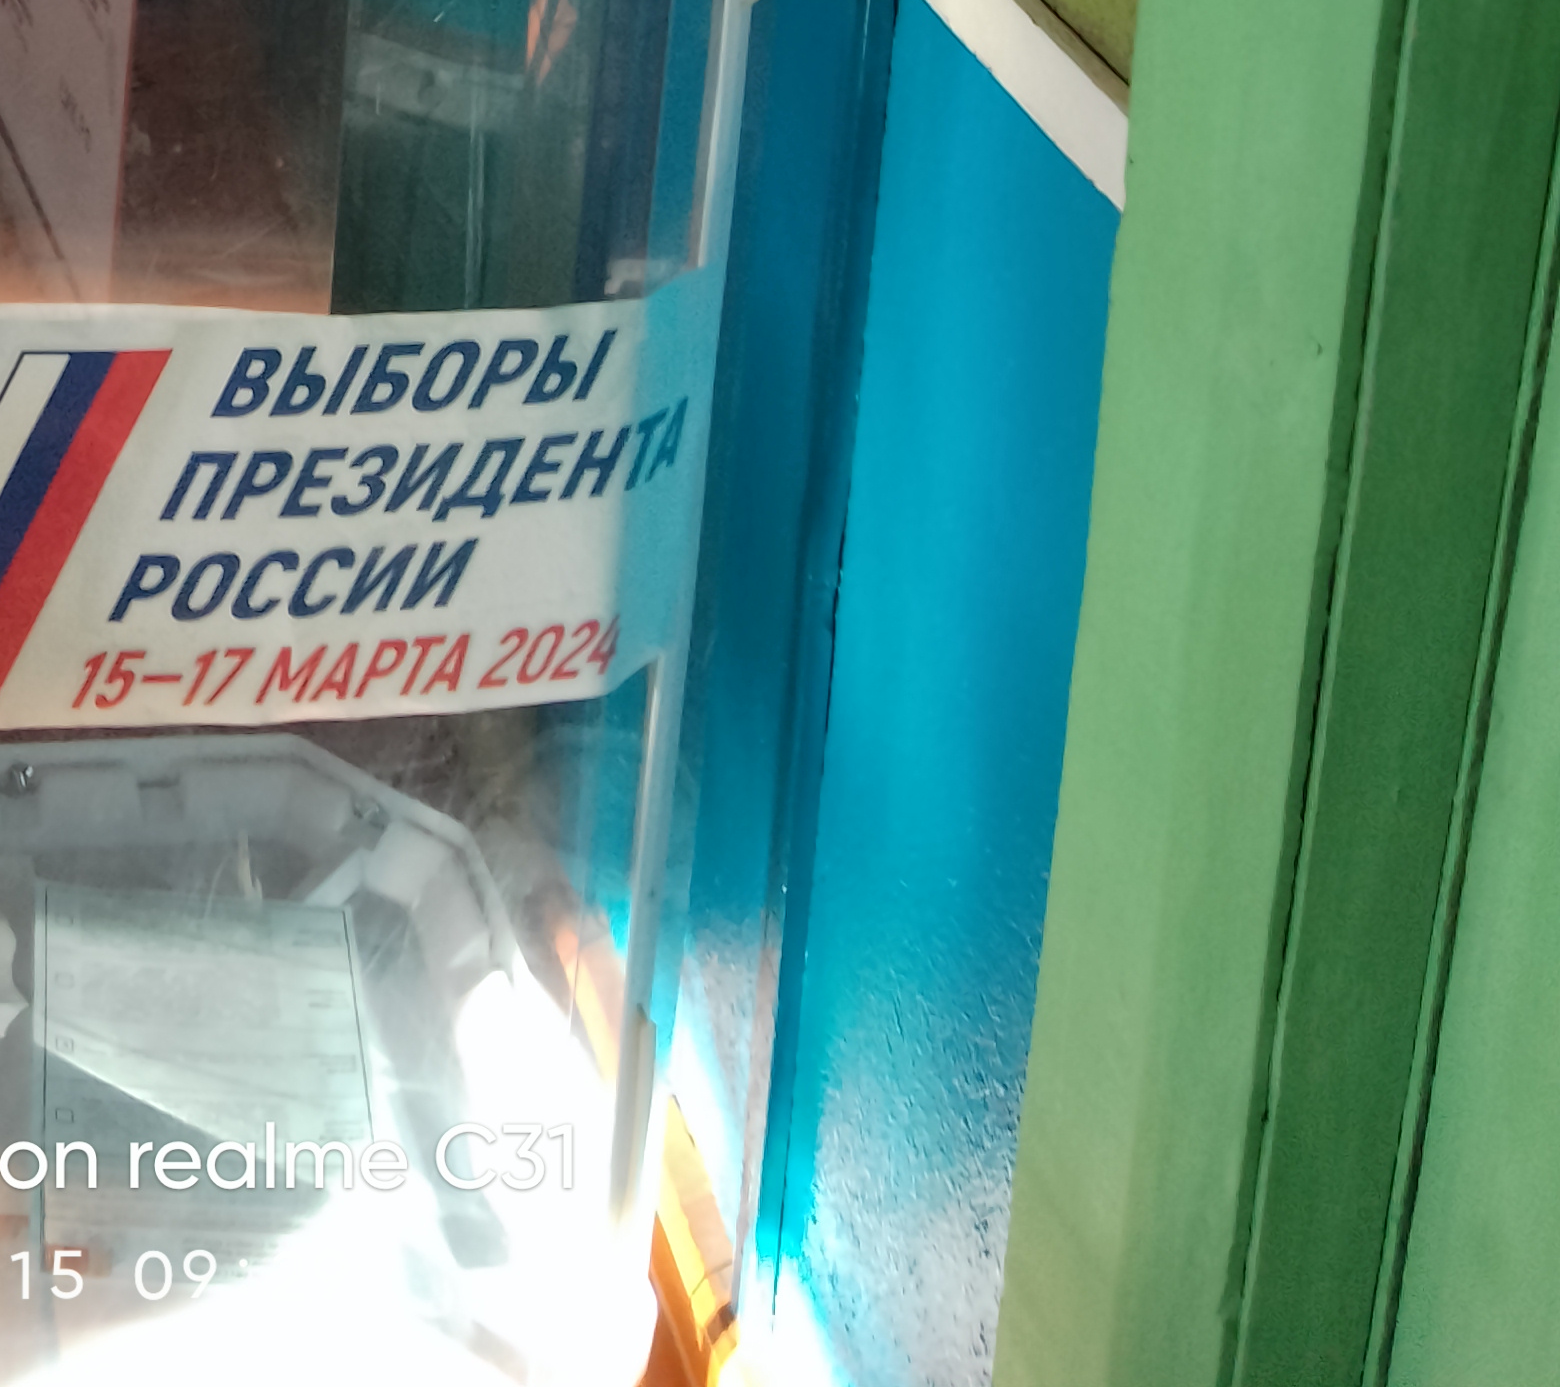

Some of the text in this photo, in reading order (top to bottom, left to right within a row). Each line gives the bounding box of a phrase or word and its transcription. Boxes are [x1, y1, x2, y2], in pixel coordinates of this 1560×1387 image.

[211, 328, 618, 421] ВЫБОРЫ
[158, 394, 692, 523] ПРЕЗИДЕНТА
[108, 537, 480, 625] РОССИИ
[254, 630, 466, 707] МАРТА
[477, 616, 622, 691] 2024
